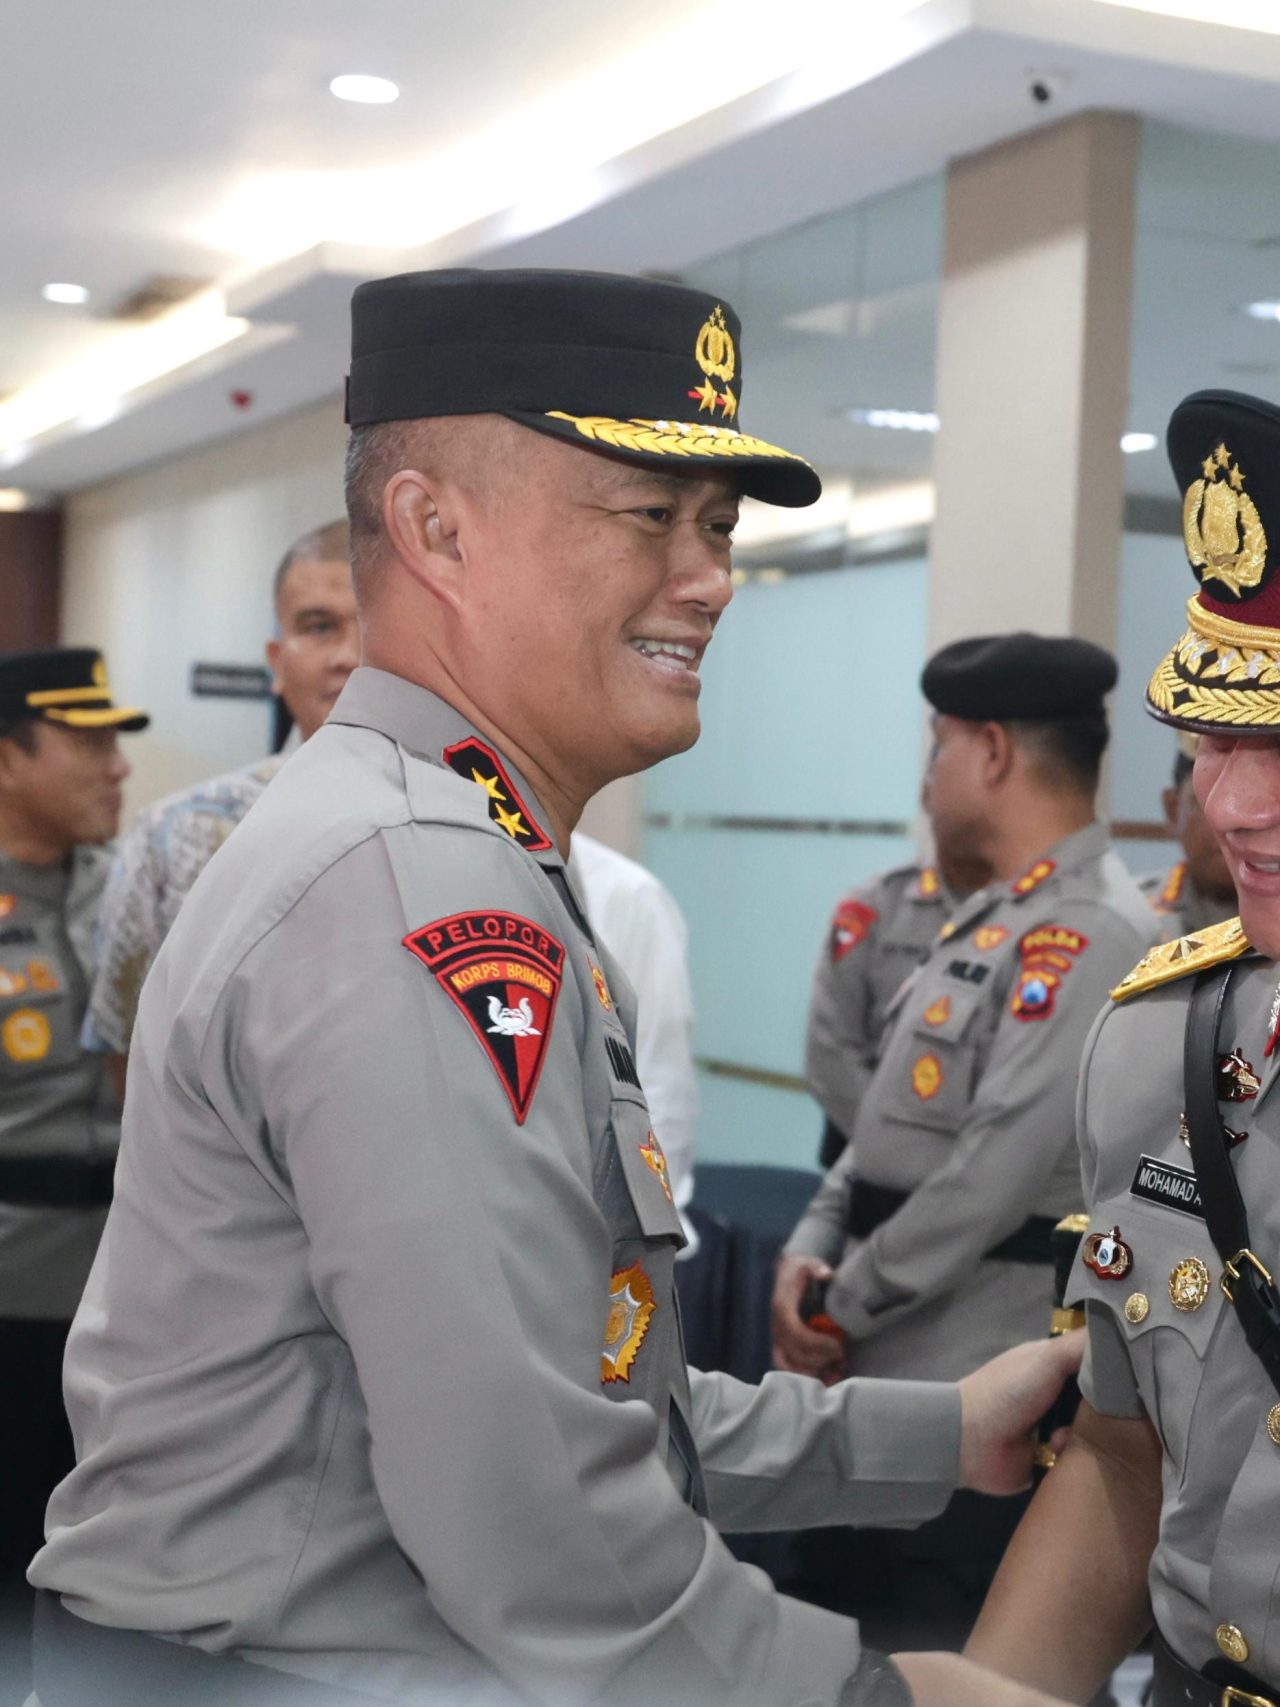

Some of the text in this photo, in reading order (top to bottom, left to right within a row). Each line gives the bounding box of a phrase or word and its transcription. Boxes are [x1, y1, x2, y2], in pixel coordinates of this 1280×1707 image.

[426, 918, 550, 955] PELOPOR
[451, 962, 553, 994] KORPS BRIMOB
[1138, 1167, 1195, 1202] MOHAMAD
